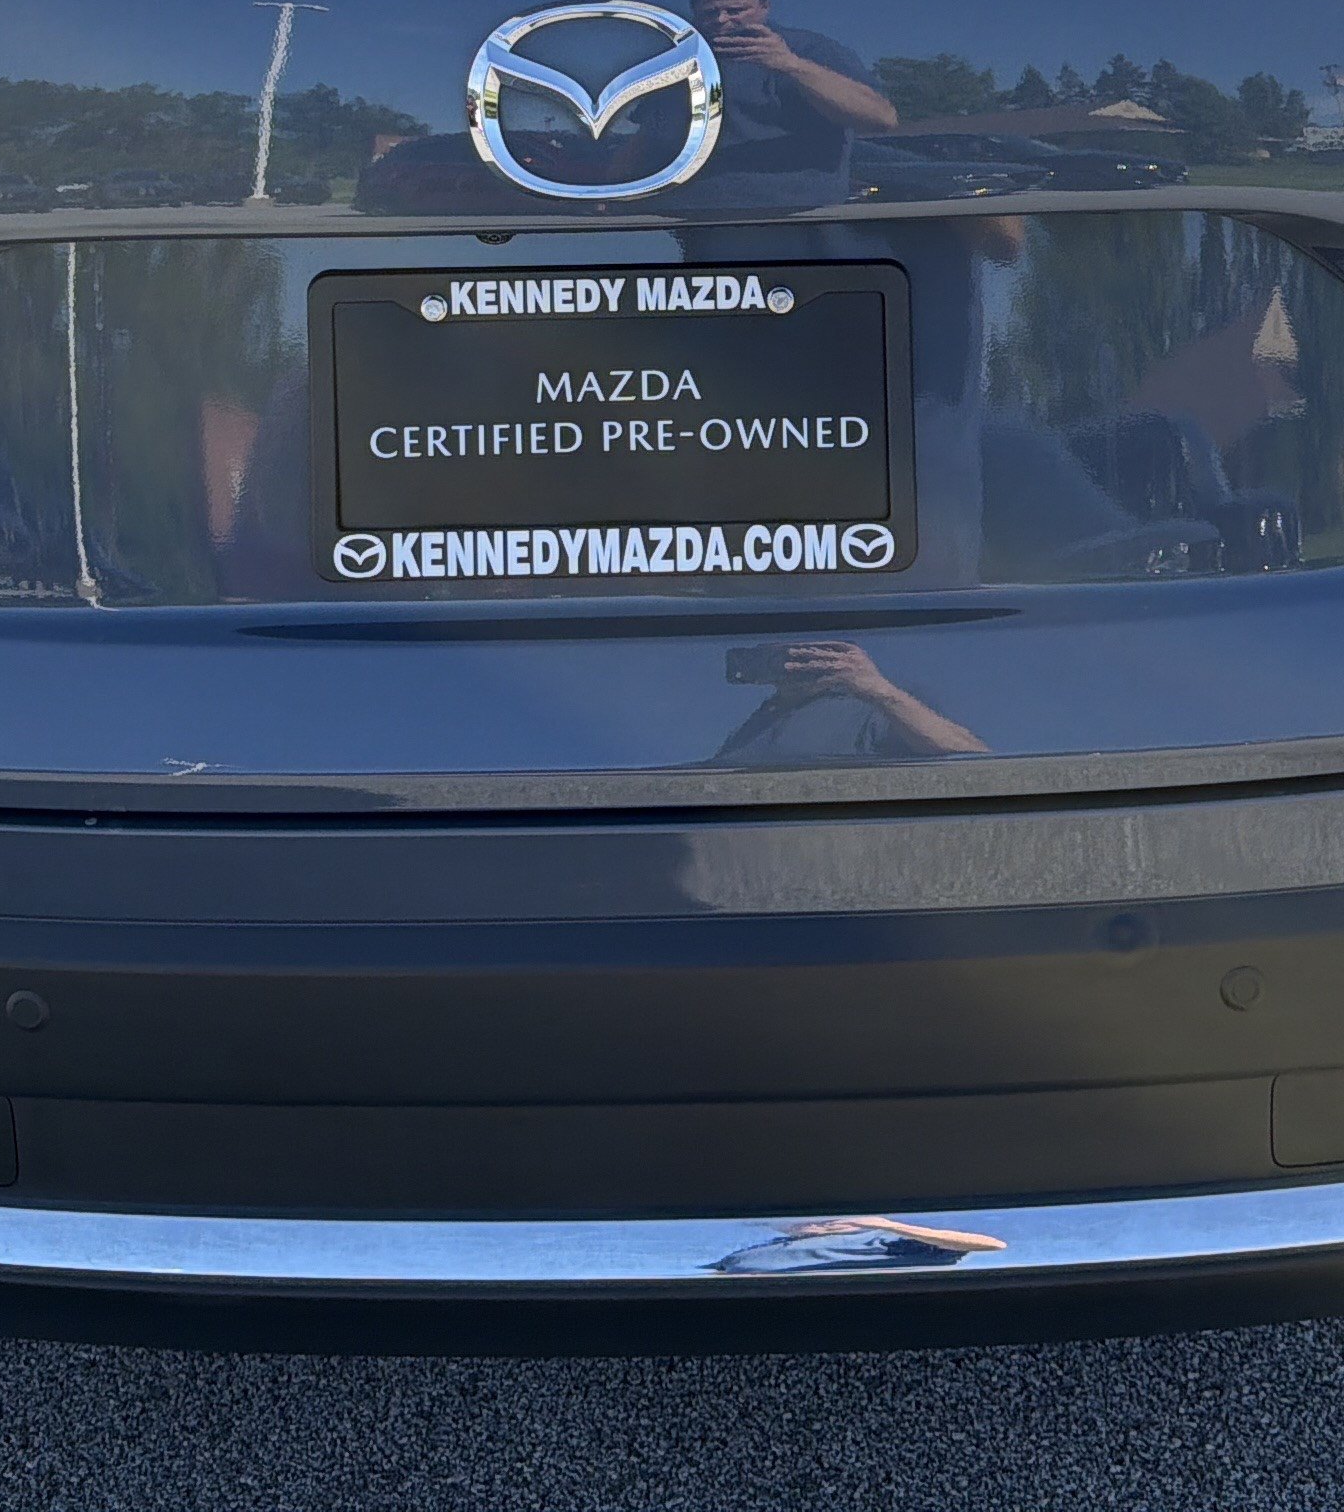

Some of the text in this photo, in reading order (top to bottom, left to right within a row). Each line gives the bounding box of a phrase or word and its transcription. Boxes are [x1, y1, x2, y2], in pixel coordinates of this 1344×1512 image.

[450, 274, 766, 316] KENNEDY MAZDA
[536, 369, 702, 404] MAZDA
[369, 416, 870, 460] CERTIFIED PRE-OWNED
[391, 524, 838, 579] KENNEDYMAZDA.COM
